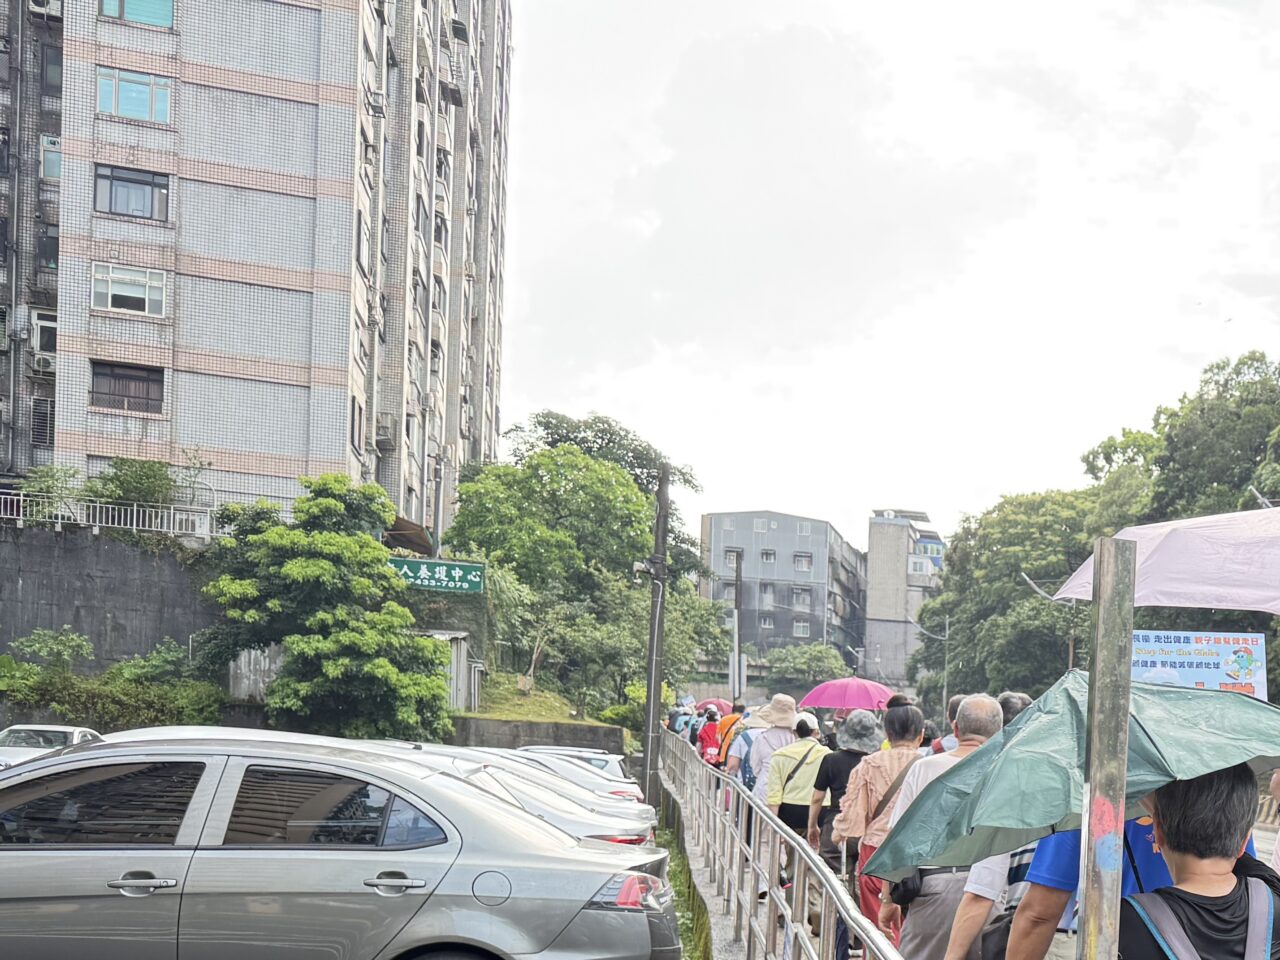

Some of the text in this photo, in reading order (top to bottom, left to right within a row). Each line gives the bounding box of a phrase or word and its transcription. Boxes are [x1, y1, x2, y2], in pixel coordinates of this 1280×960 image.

[387, 562, 481, 582] 人養護中心
